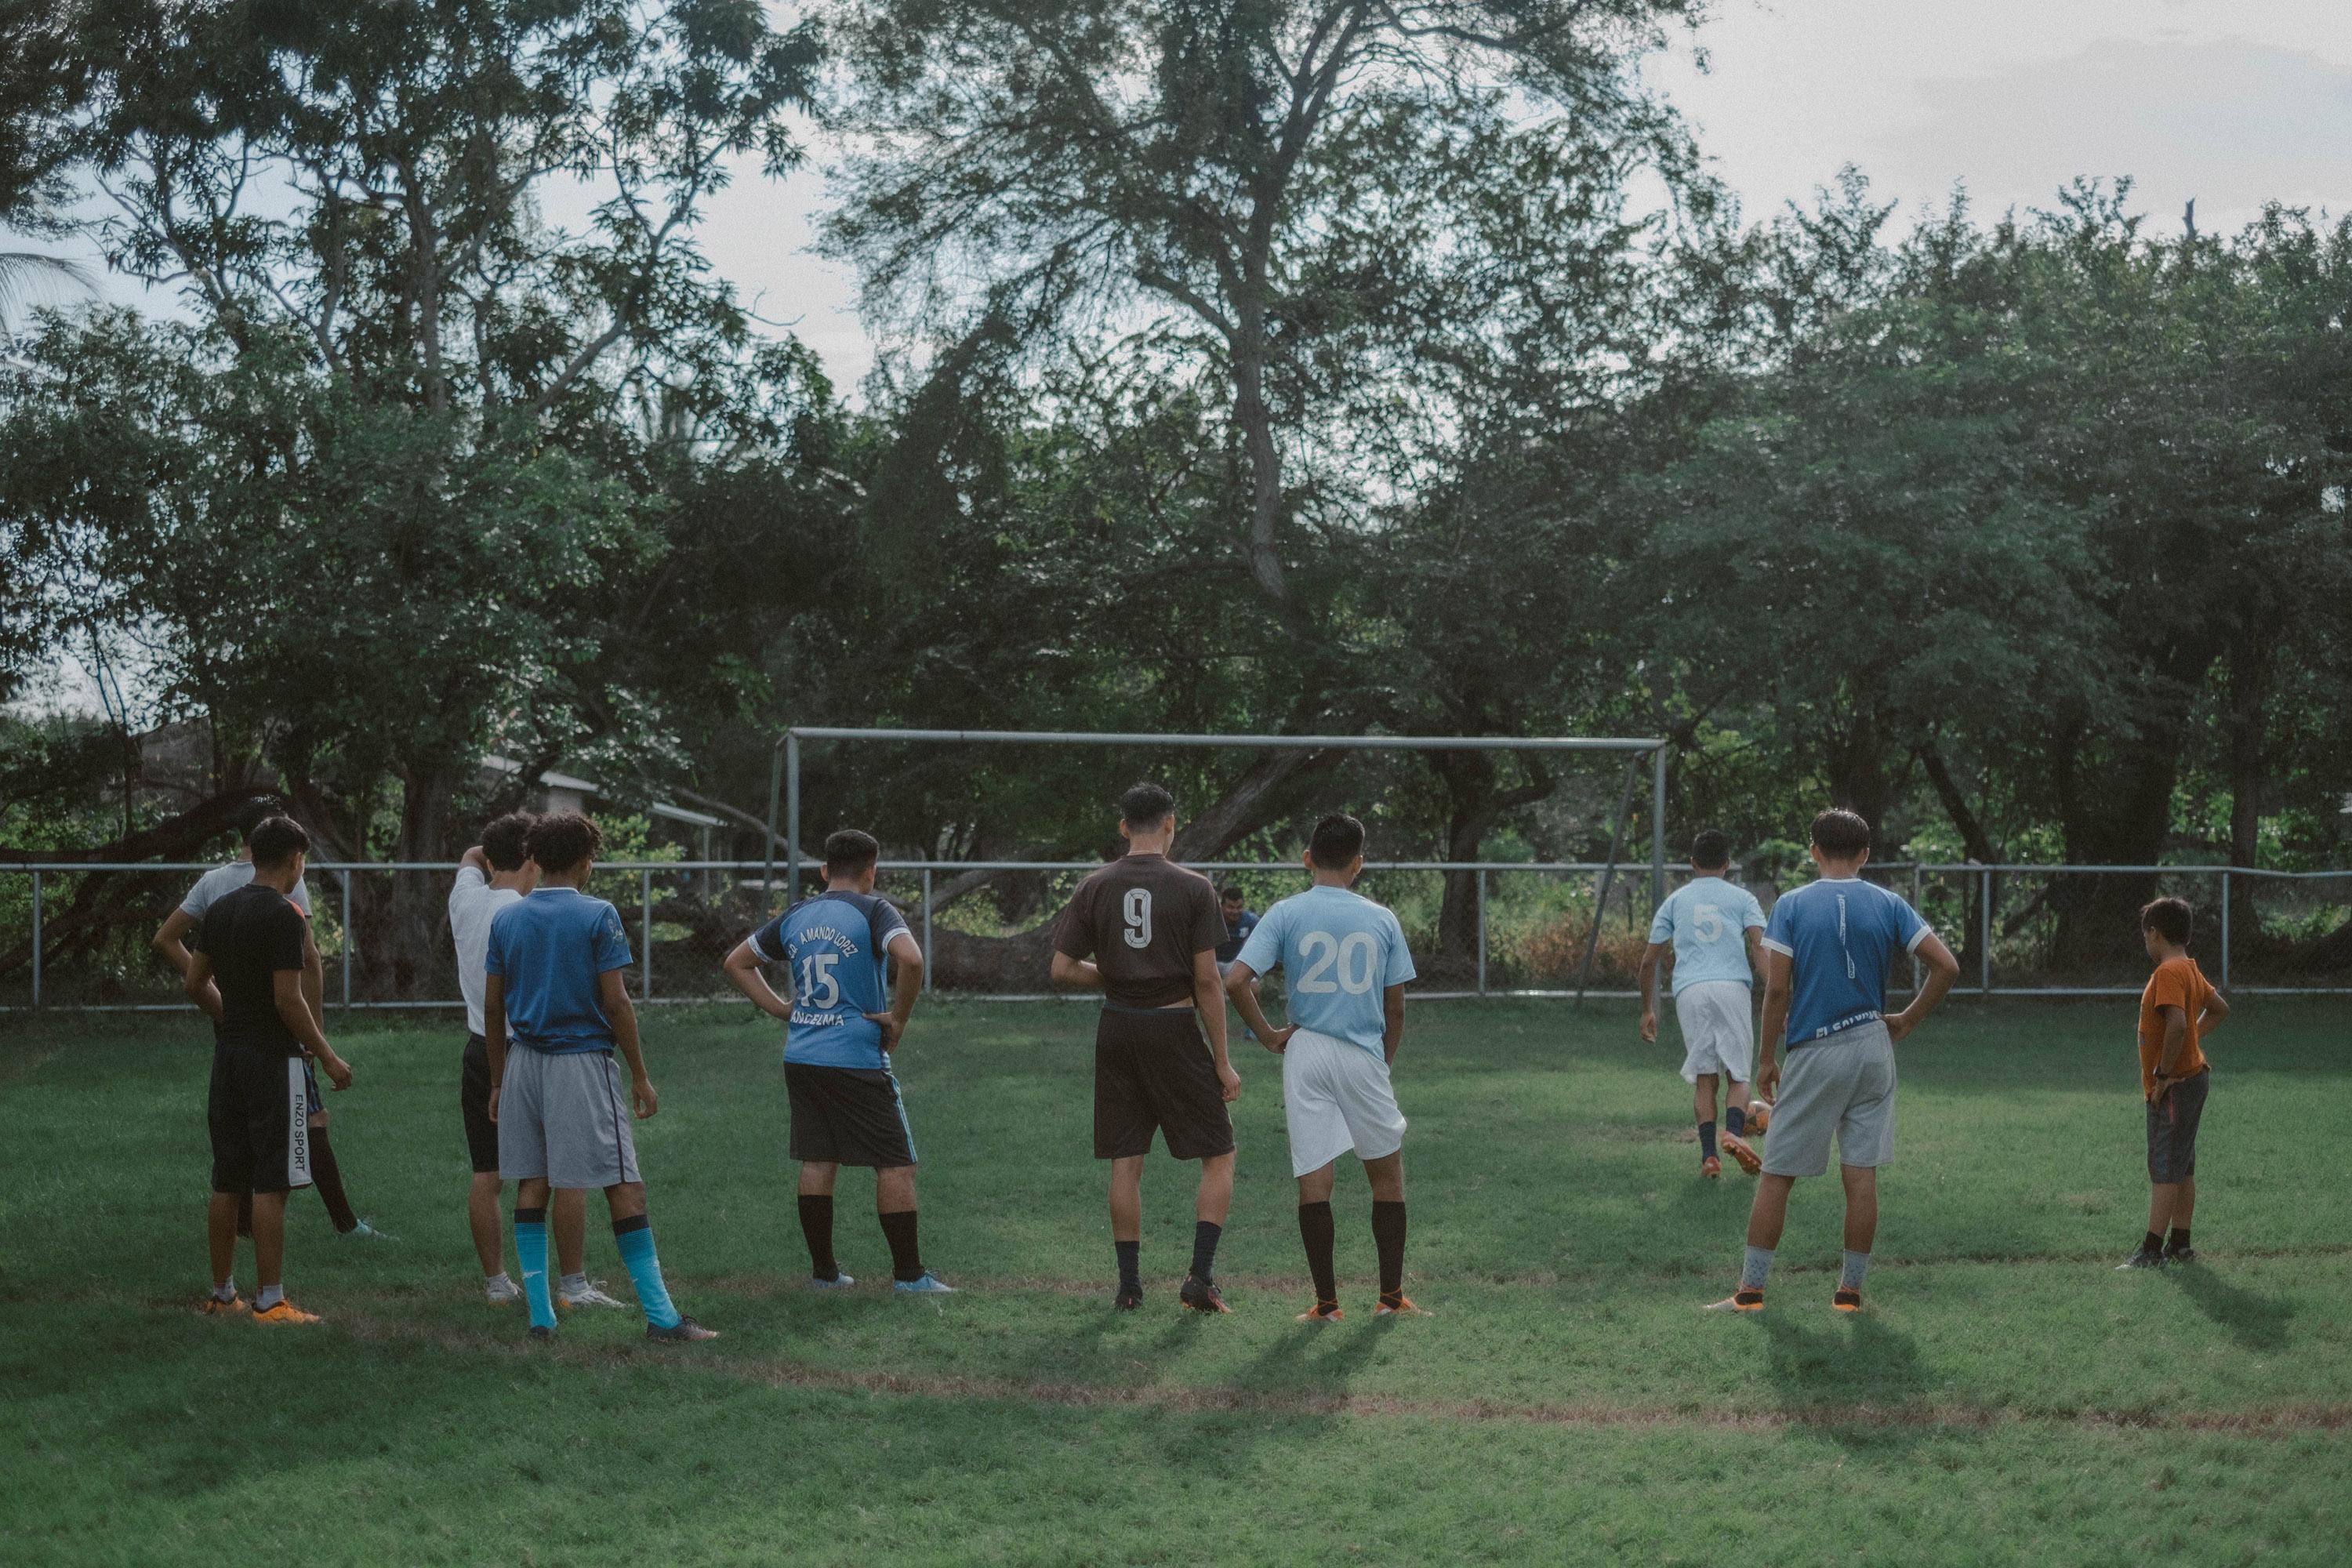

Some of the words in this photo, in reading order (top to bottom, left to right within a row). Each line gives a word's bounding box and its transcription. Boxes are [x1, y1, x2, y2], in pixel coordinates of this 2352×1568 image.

[1123, 888, 1152, 949] 9
[1693, 903, 1723, 942] 5
[833, 931, 859, 958] LOPEZ
[1297, 931, 1377, 995] 20
[800, 953, 840, 1009] 15
[294, 1094, 304, 1127] ENZO
[294, 1131, 305, 1172] SPORT
